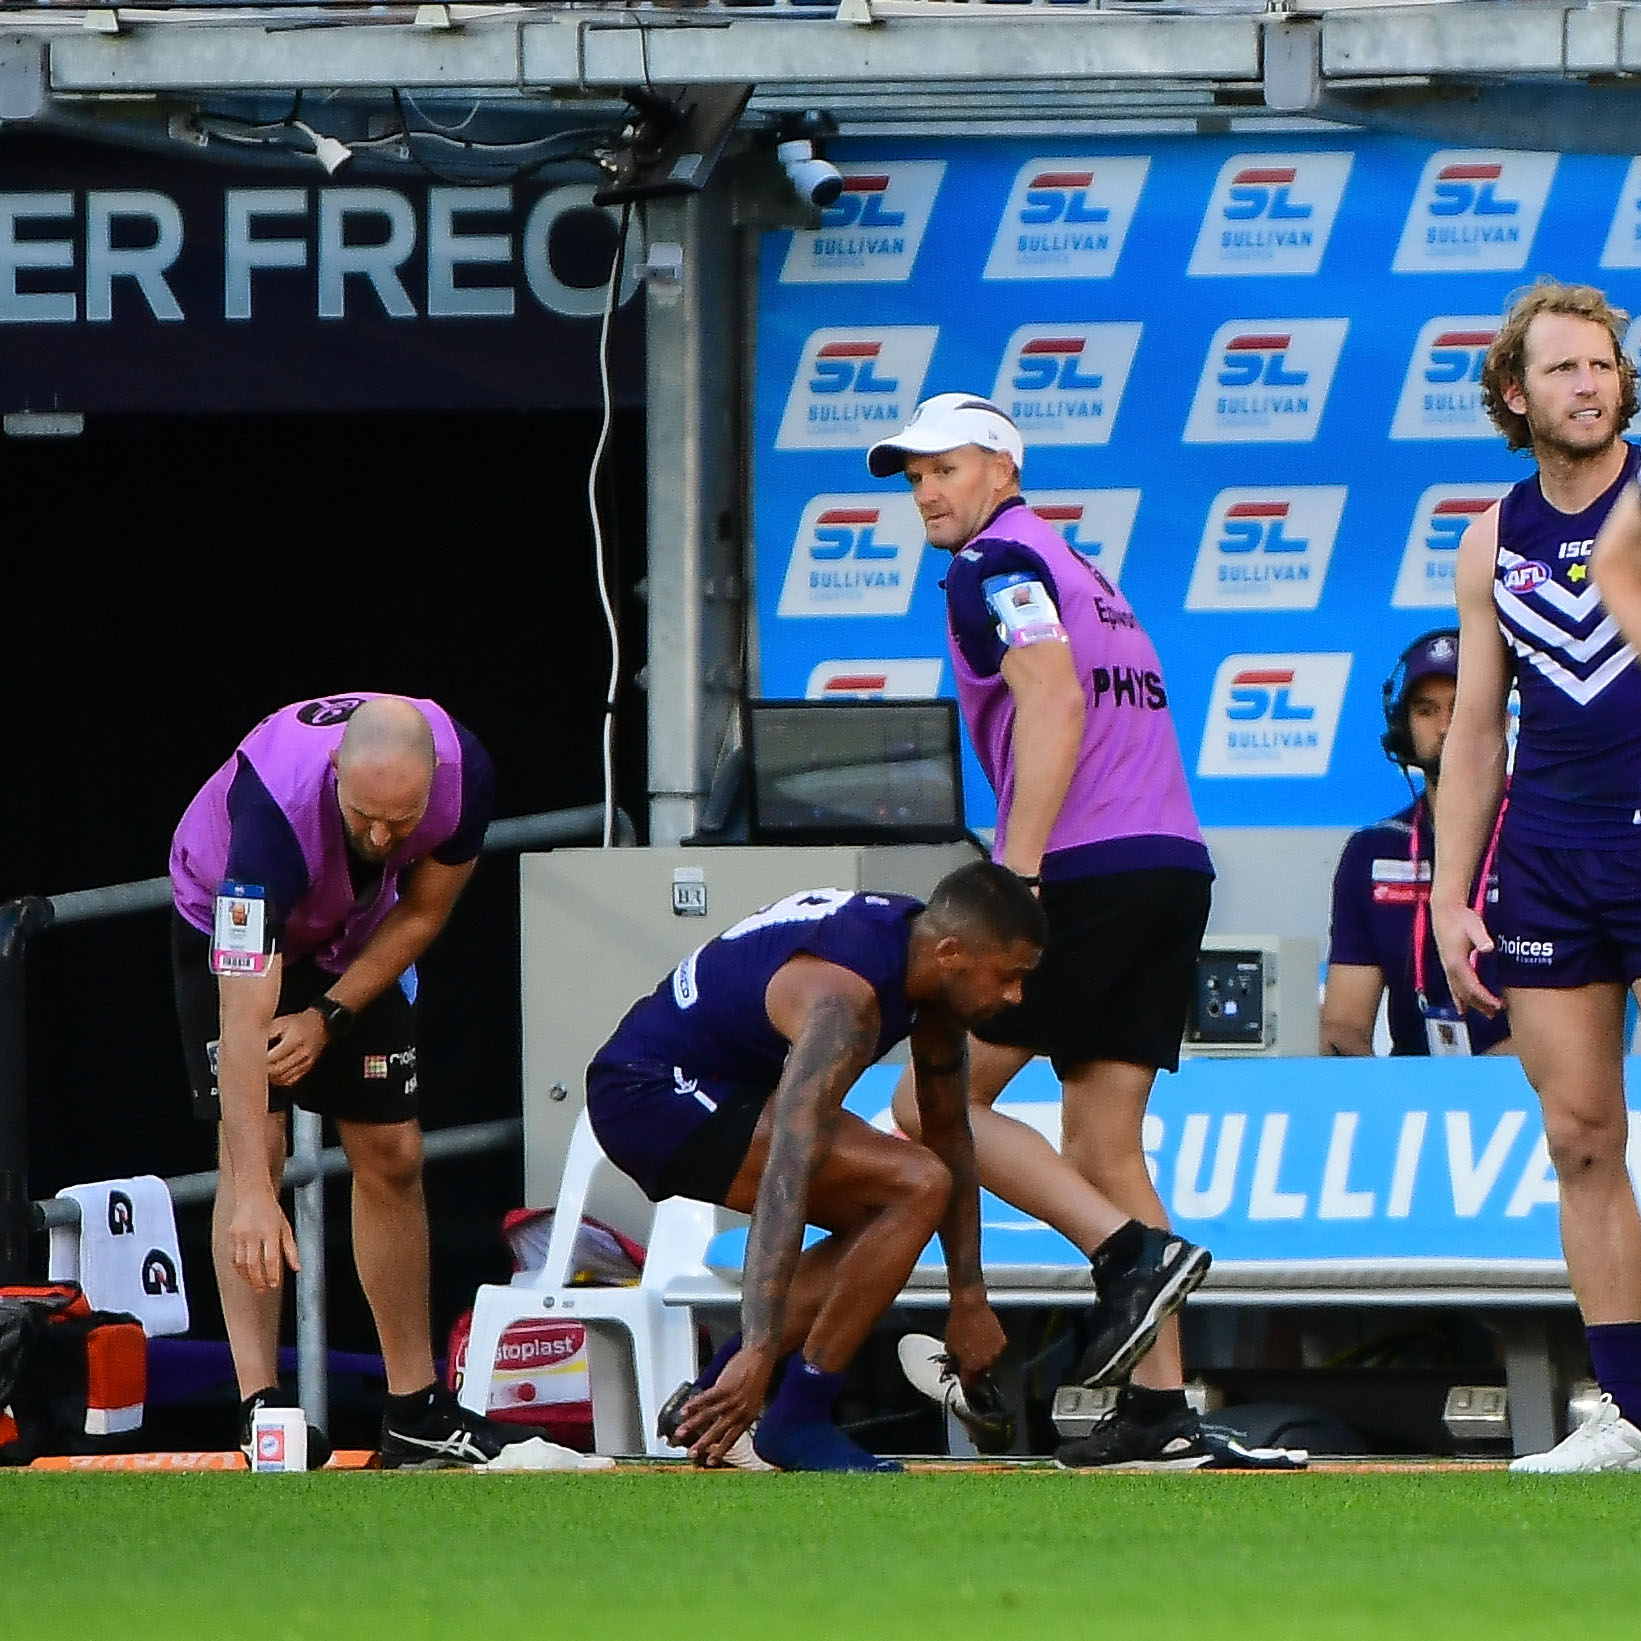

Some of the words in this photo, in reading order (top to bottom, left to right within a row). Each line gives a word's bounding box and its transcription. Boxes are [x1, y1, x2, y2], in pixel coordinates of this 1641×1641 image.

[1019, 235, 1112, 254] SULLIVAN
[1221, 231, 1314, 250] SULLIVAN
[1427, 227, 1520, 246] SULLIVAN
[223, 186, 646, 322] FREO
[812, 239, 905, 258] SULLIVAN
[808, 405, 901, 424] SULLIVAN
[1010, 402, 1103, 421] SULLIVAN
[1216, 398, 1309, 417] SULLIVAN
[806, 571, 899, 590] SULLIVAN
[1216, 564, 1309, 583] SULLIVAN
[1504, 566, 1546, 588] AFL
[1221, 732, 1314, 751] SULLIVAN
[495, 1333, 576, 1364] stoplast
